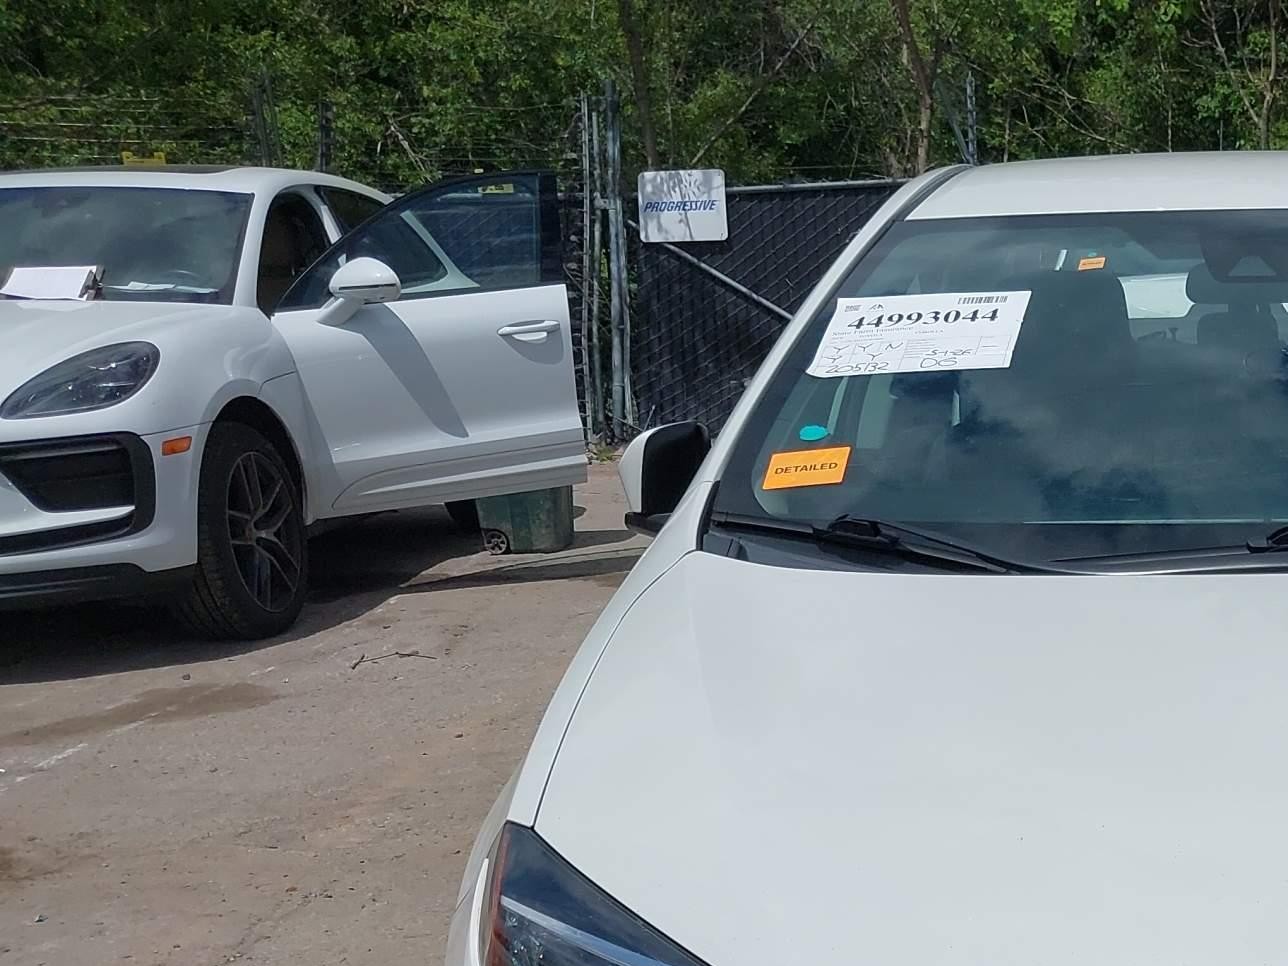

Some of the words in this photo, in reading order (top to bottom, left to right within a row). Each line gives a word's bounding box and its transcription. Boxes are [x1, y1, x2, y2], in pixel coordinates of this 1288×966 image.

[644, 200, 718, 212] PROGRESSIVE
[847, 308, 999, 330] 44993044
[774, 462, 838, 475] DETAILED
